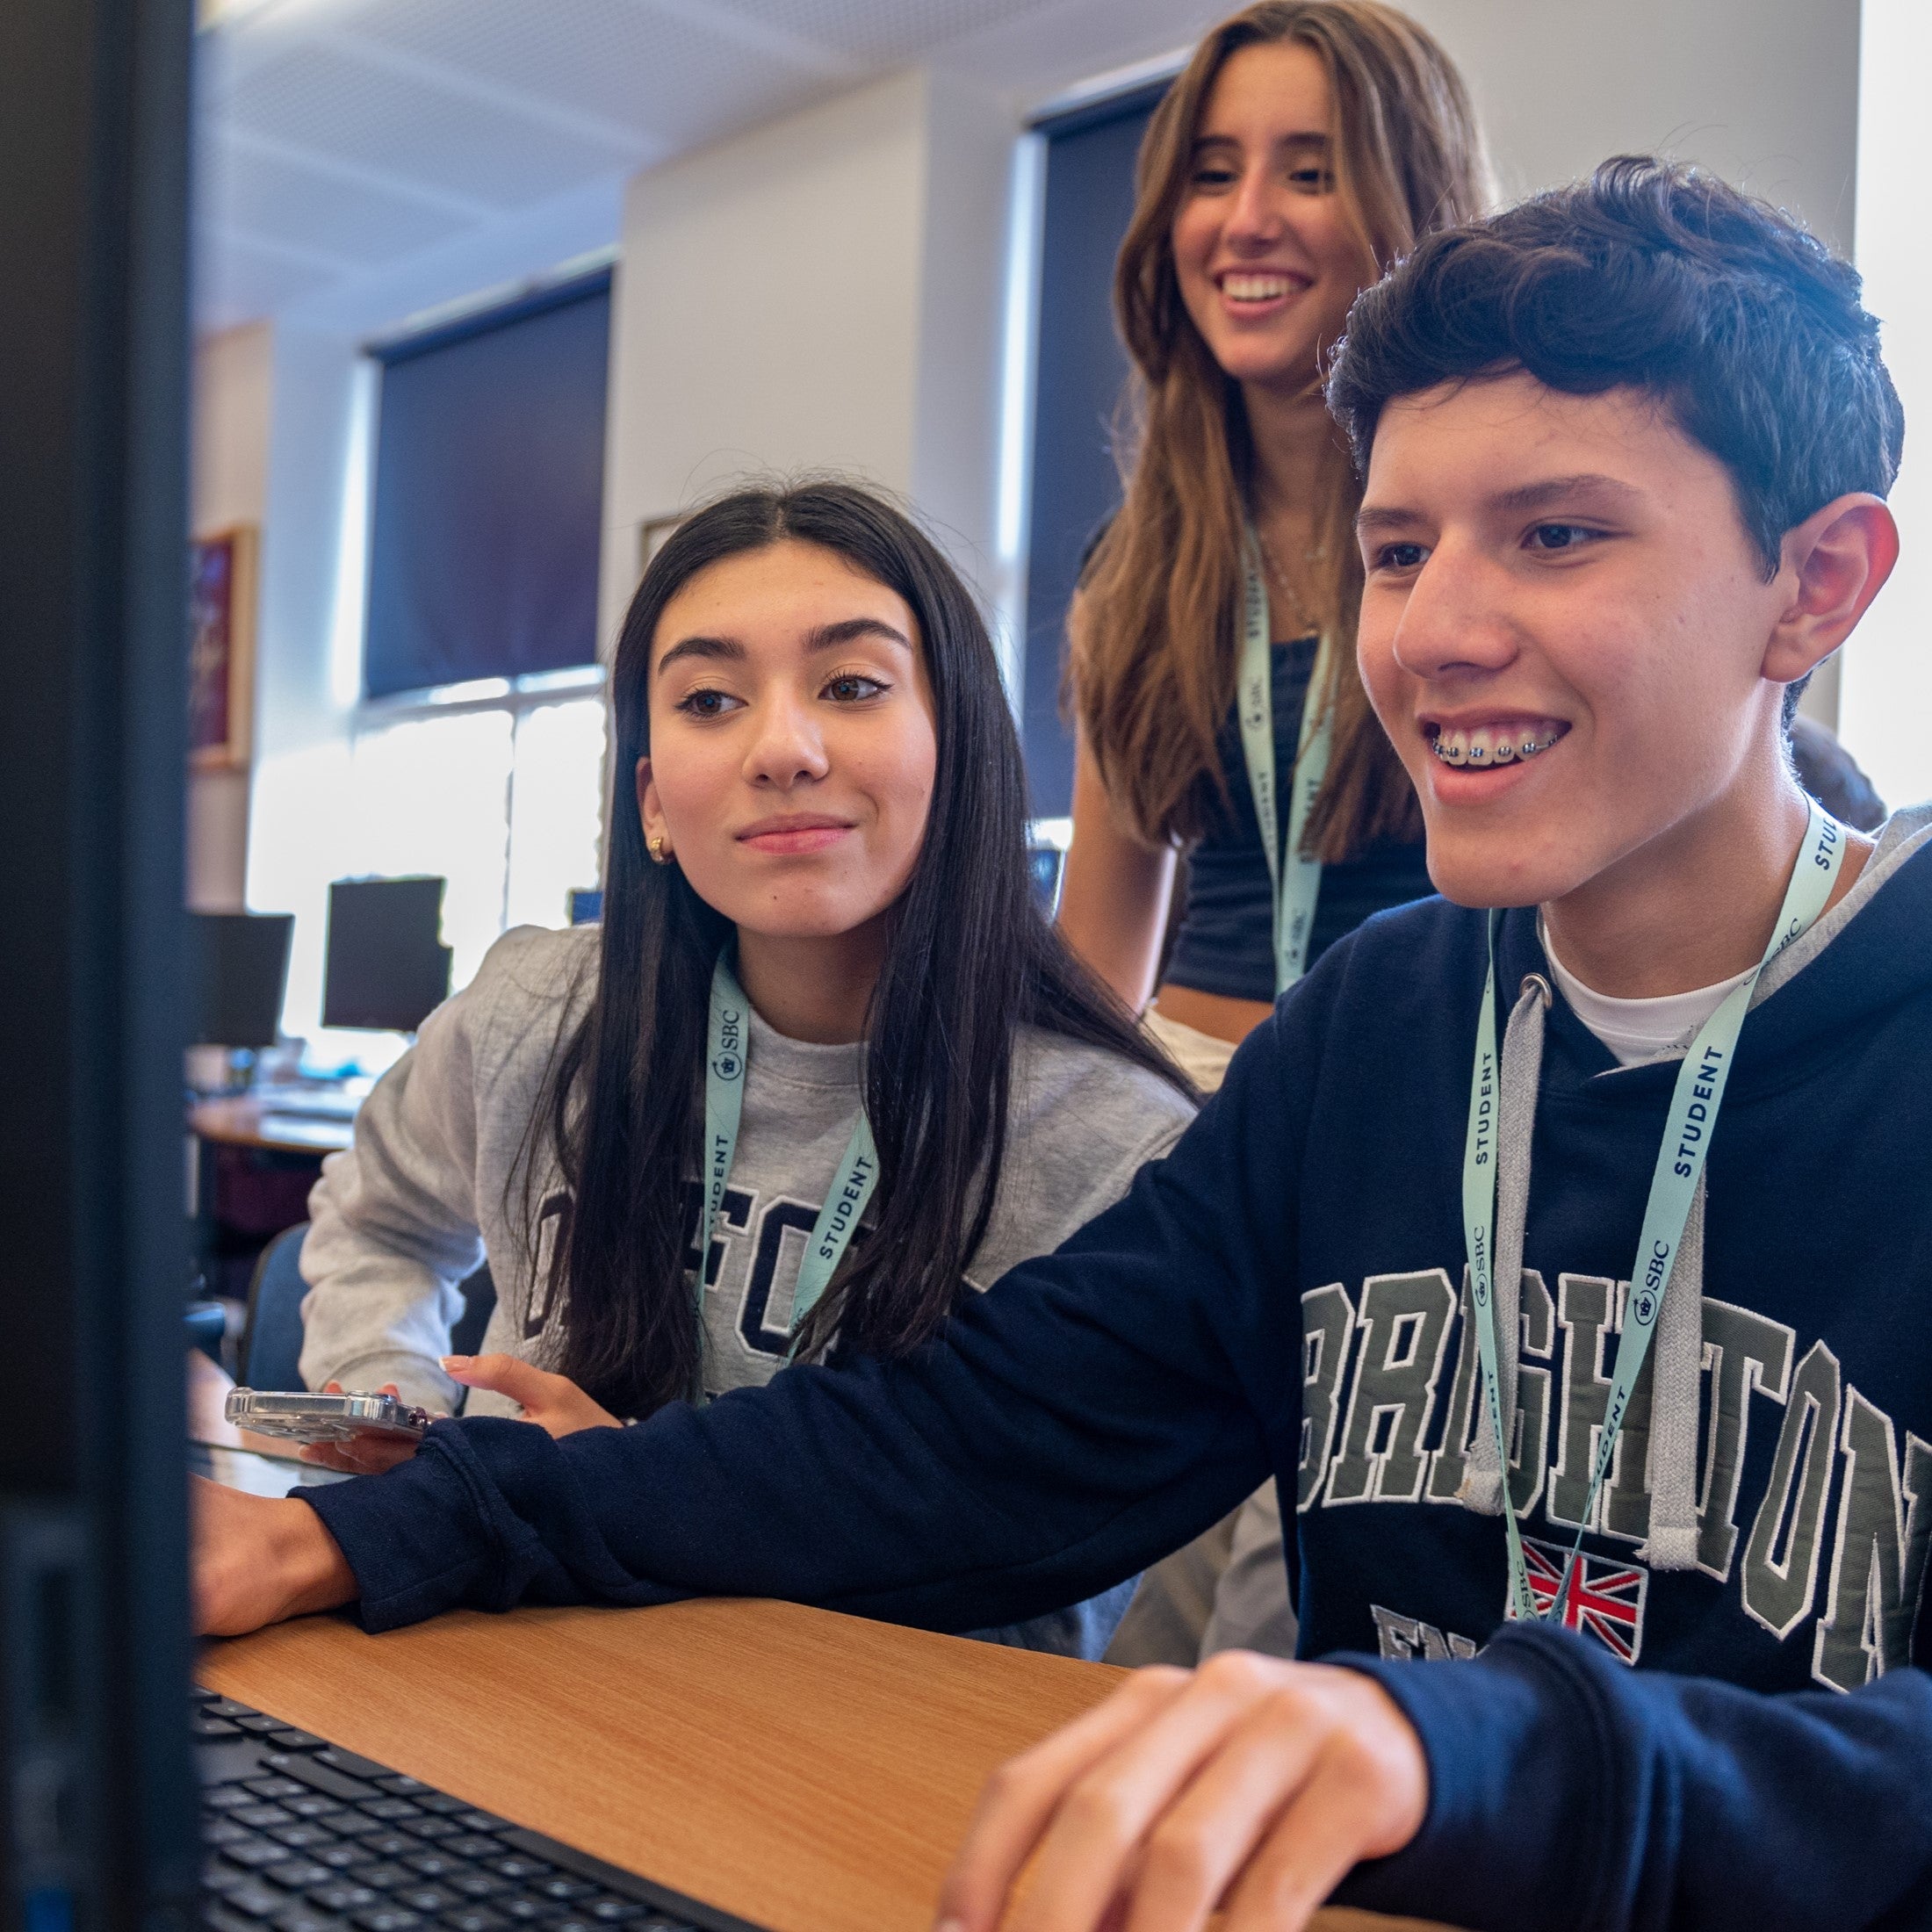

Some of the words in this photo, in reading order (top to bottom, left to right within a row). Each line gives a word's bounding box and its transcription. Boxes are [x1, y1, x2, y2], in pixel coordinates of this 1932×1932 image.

[722, 1009, 739, 1050] SBC
[1475, 1053, 1492, 1165] STUDENT
[1674, 1046, 1723, 1179] STUDENT
[819, 1157, 872, 1260] STUDENT
[1474, 1225, 1485, 1272] SBC
[1645, 1239, 1670, 1291] SBC
